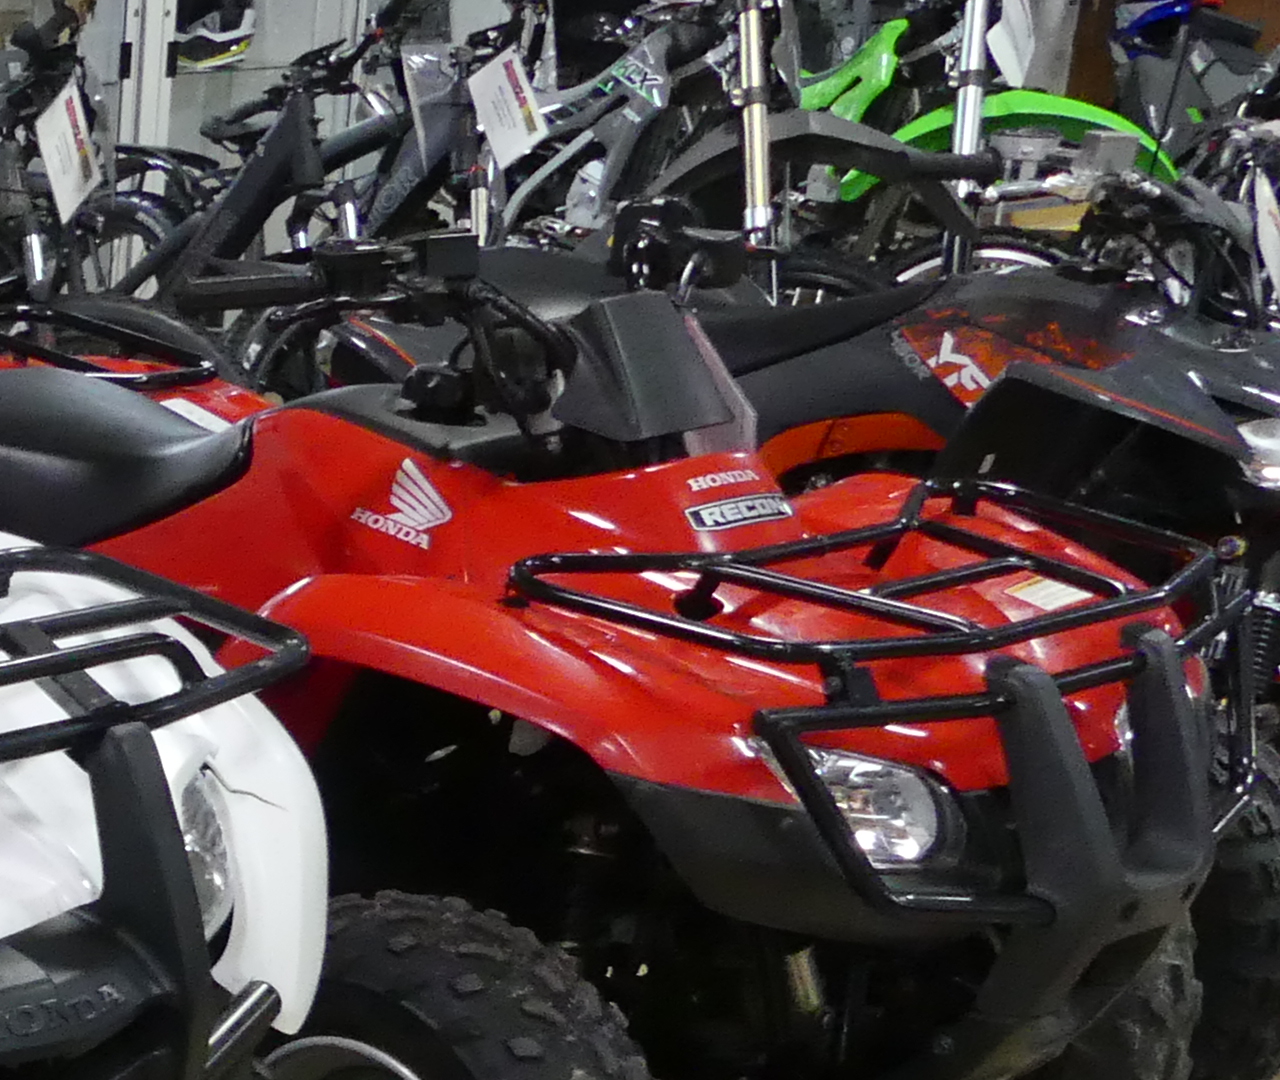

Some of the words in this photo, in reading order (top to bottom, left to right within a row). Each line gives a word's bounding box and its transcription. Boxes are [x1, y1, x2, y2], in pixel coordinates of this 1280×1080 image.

[686, 469, 760, 492] HONDA
[699, 497, 786, 526] RECON
[350, 507, 429, 550] HONDA
